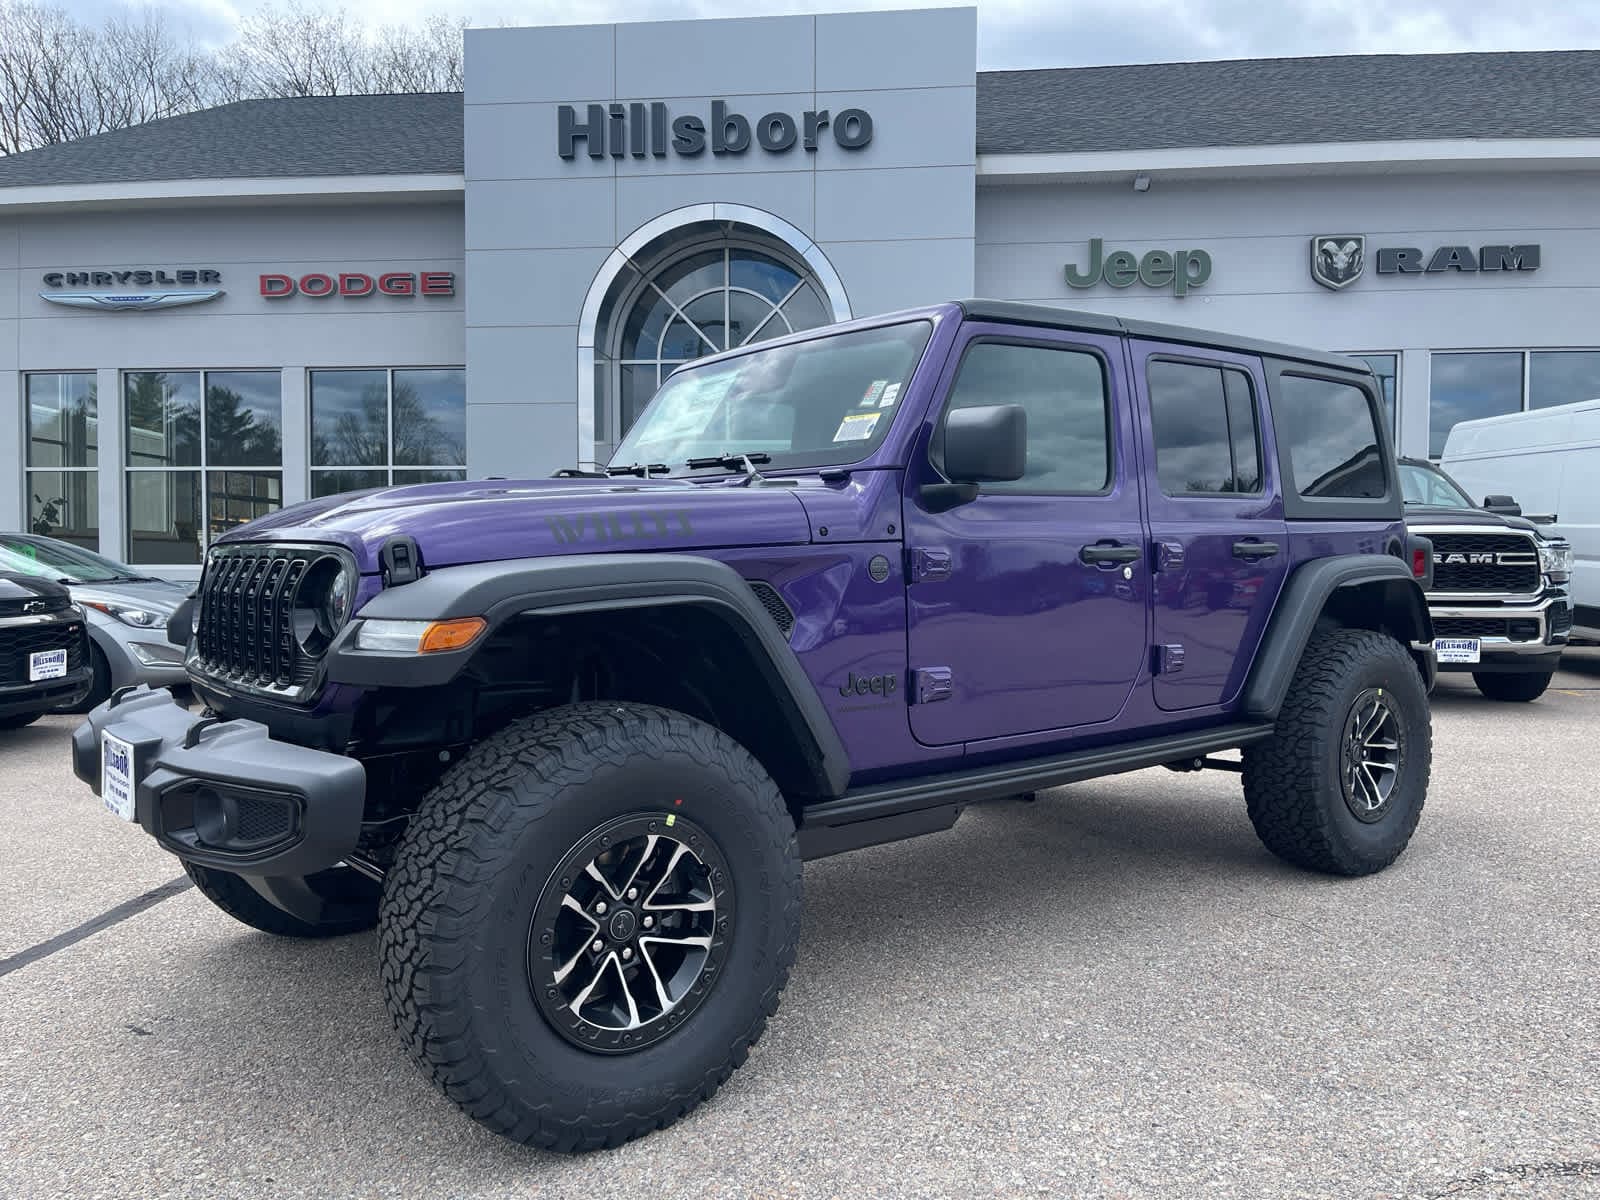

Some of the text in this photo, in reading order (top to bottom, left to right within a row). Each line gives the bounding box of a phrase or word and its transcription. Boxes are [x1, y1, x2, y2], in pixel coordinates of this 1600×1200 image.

[557, 100, 873, 160] Hillsboro
[1064, 238, 1212, 298] Jeep
[1376, 244, 1541, 275] RAM
[43, 269, 221, 287] CHRYSLER
[259, 271, 455, 299] DODGE
[1433, 552, 1493, 565] RAM
[839, 672, 897, 698] Jeep
